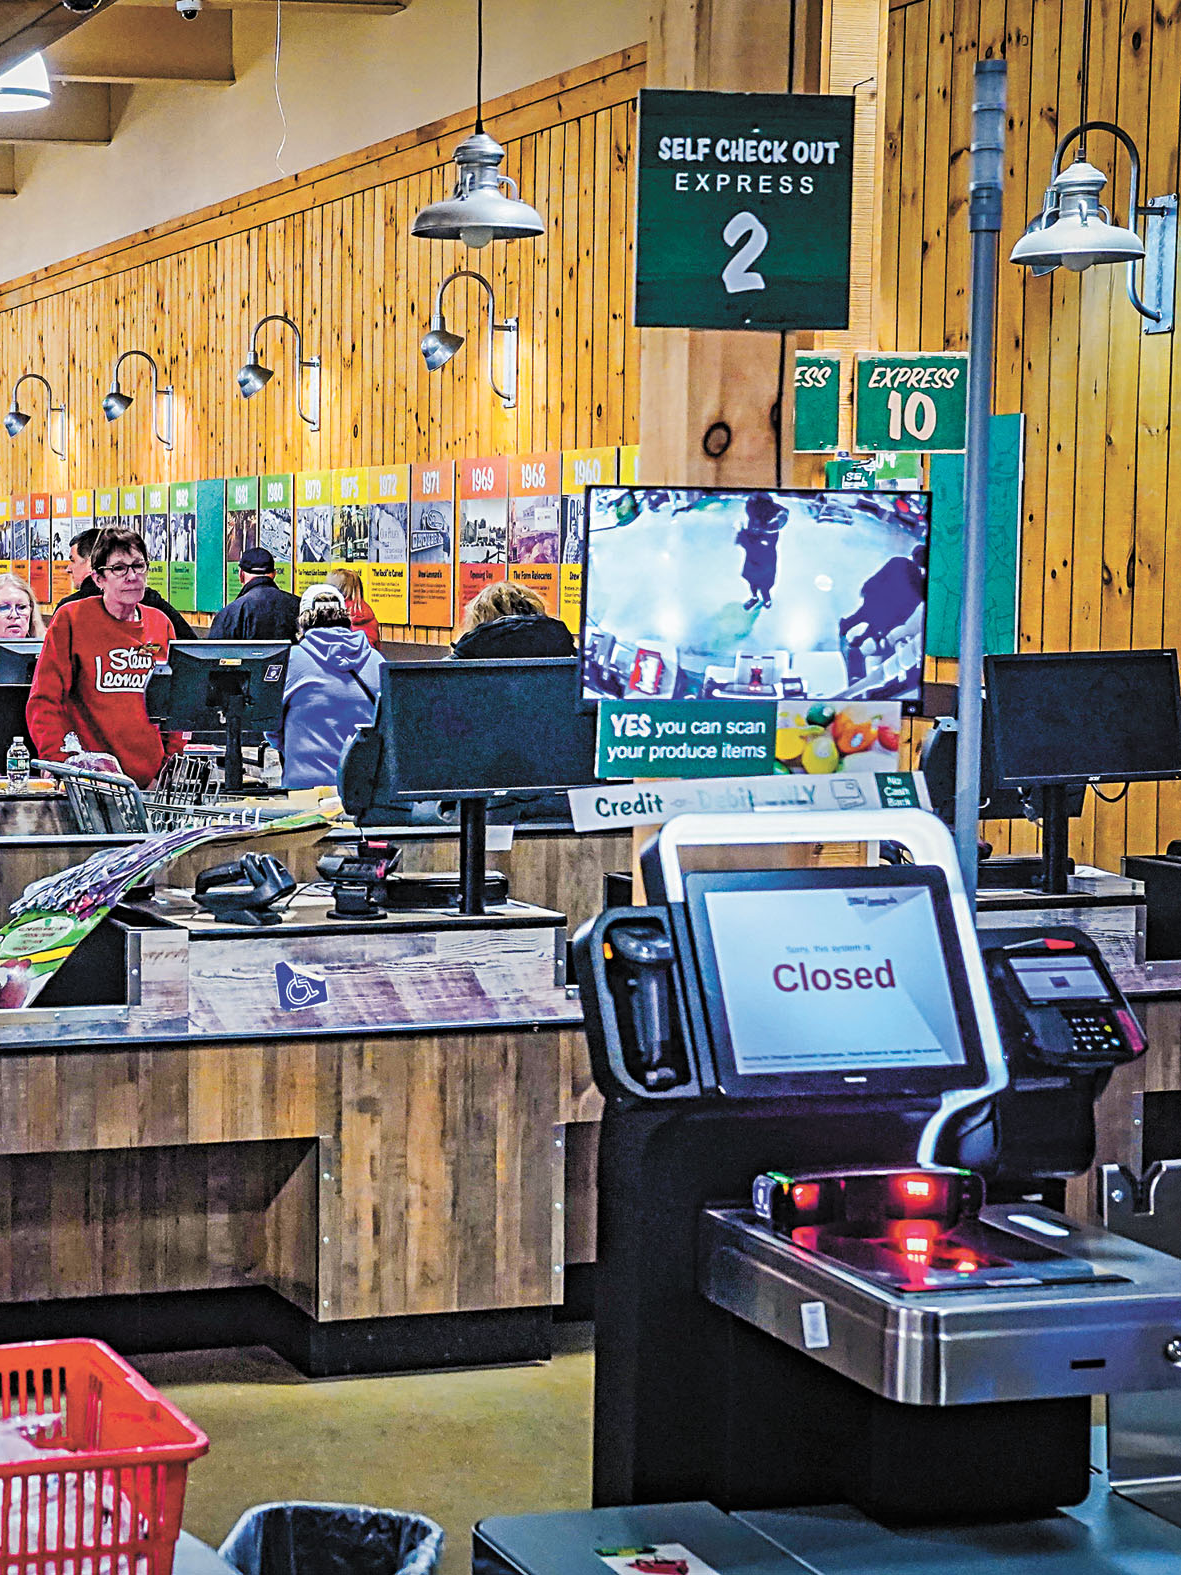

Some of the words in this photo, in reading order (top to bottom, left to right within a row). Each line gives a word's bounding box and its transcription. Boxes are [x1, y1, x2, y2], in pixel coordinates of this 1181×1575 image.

[658, 137, 711, 161] SELF
[715, 137, 788, 163] CHECK
[792, 141, 840, 164] OUT
[675, 173, 814, 194] EXPRESS
[721, 211, 769, 294] 2
[868, 367, 959, 389] EXPRESS
[887, 390, 937, 441] 10
[422, 471, 440, 494] 1971
[472, 466, 494, 491] 1969
[521, 463, 546, 489] 1968
[573, 458, 601, 485] 1960
[235, 484, 248, 504] 1981
[267, 482, 283, 502] 1980
[305, 479, 321, 500] 1979
[341, 476, 359, 498] 1975
[379, 474, 397, 496] 1972
[108, 647, 152, 671] Stew
[610, 713, 651, 737] YES
[655, 721, 687, 738] you
[690, 720, 722, 734] can
[725, 719, 766, 734] scan
[607, 745, 646, 762] your
[649, 742, 718, 762] produce
[721, 741, 767, 759] items
[883, 787, 910, 796] Cash
[595, 793, 664, 818] Credit
[772, 958, 896, 992] Closed
